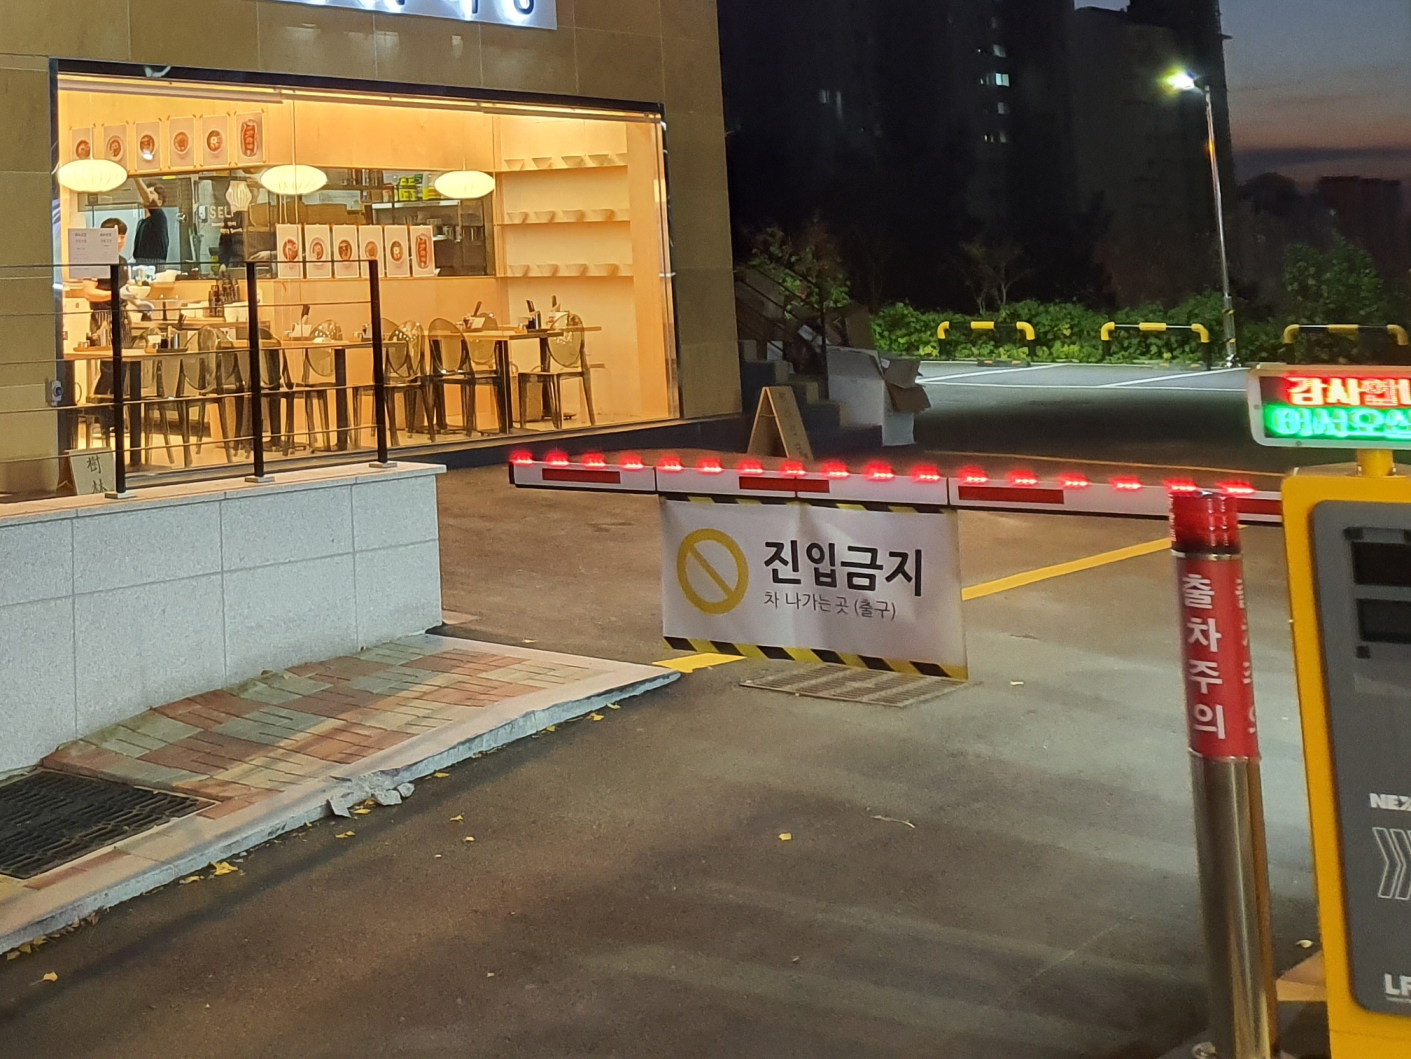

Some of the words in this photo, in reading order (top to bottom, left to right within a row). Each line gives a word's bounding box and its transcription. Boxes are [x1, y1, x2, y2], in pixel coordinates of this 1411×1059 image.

[763, 539, 923, 598] 진입금지
[763, 590, 780, 609] 차
[785, 592, 831, 613] 나가는
[835, 596, 850, 616] 곳
[854, 598, 896, 622] (출구)
[1182, 573, 1227, 740] 출차주의
